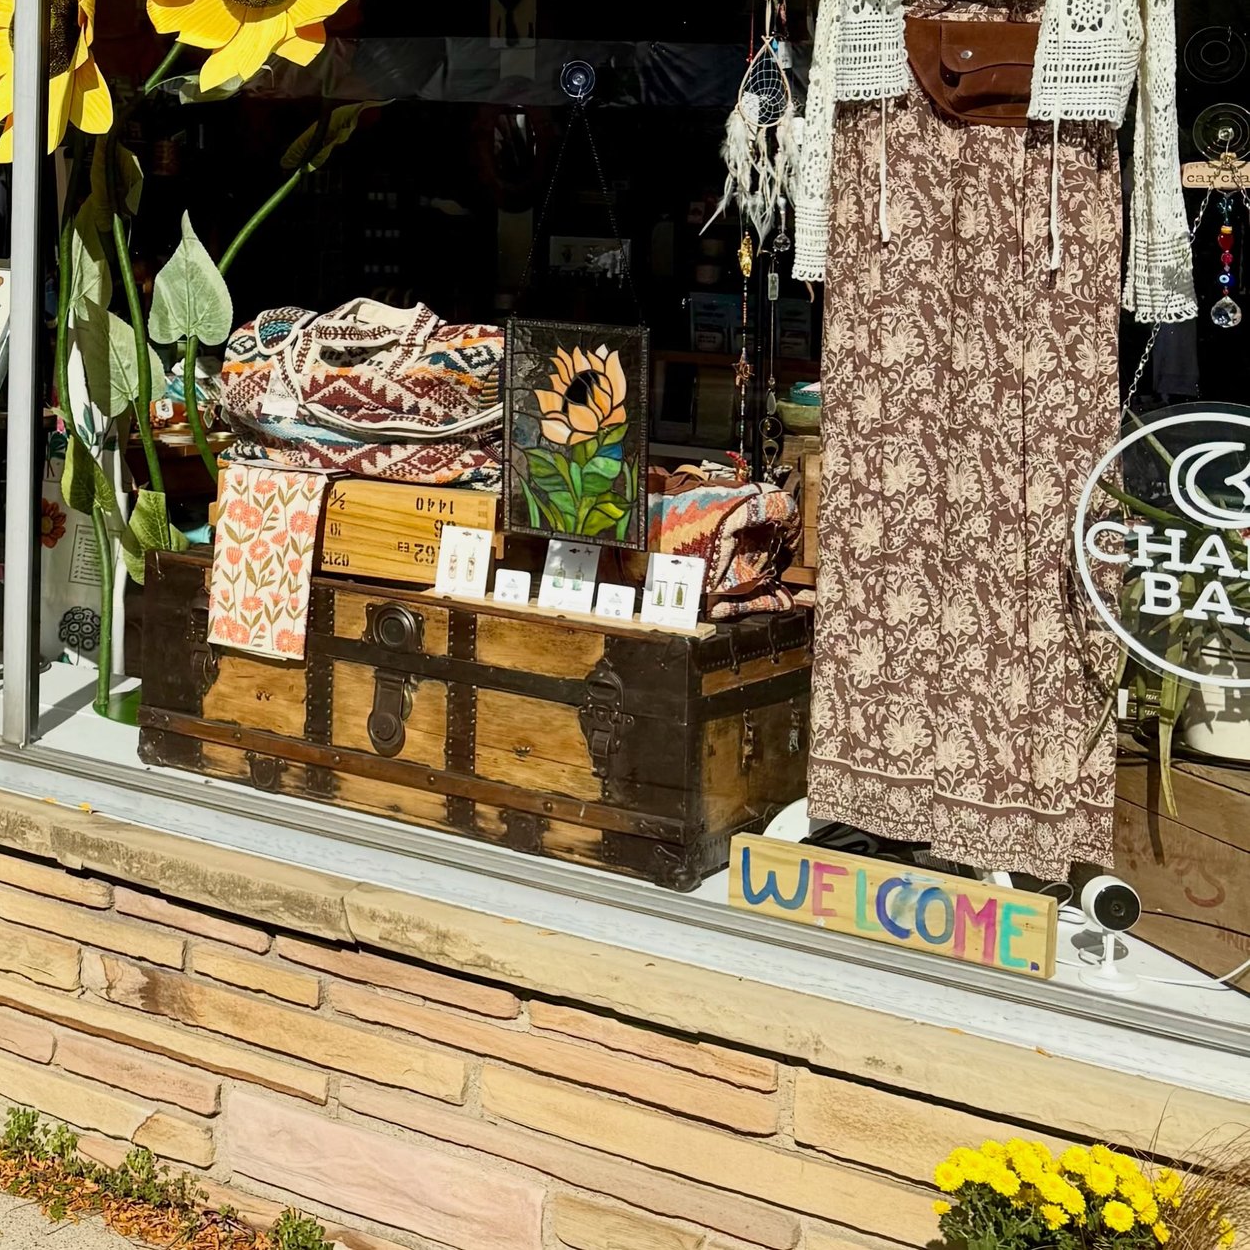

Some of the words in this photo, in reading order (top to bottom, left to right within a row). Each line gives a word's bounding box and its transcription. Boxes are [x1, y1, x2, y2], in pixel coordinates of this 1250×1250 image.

[415, 497, 455, 515] 1440
[1085, 520, 1250, 579] CHA
[1139, 571, 1250, 625] BA
